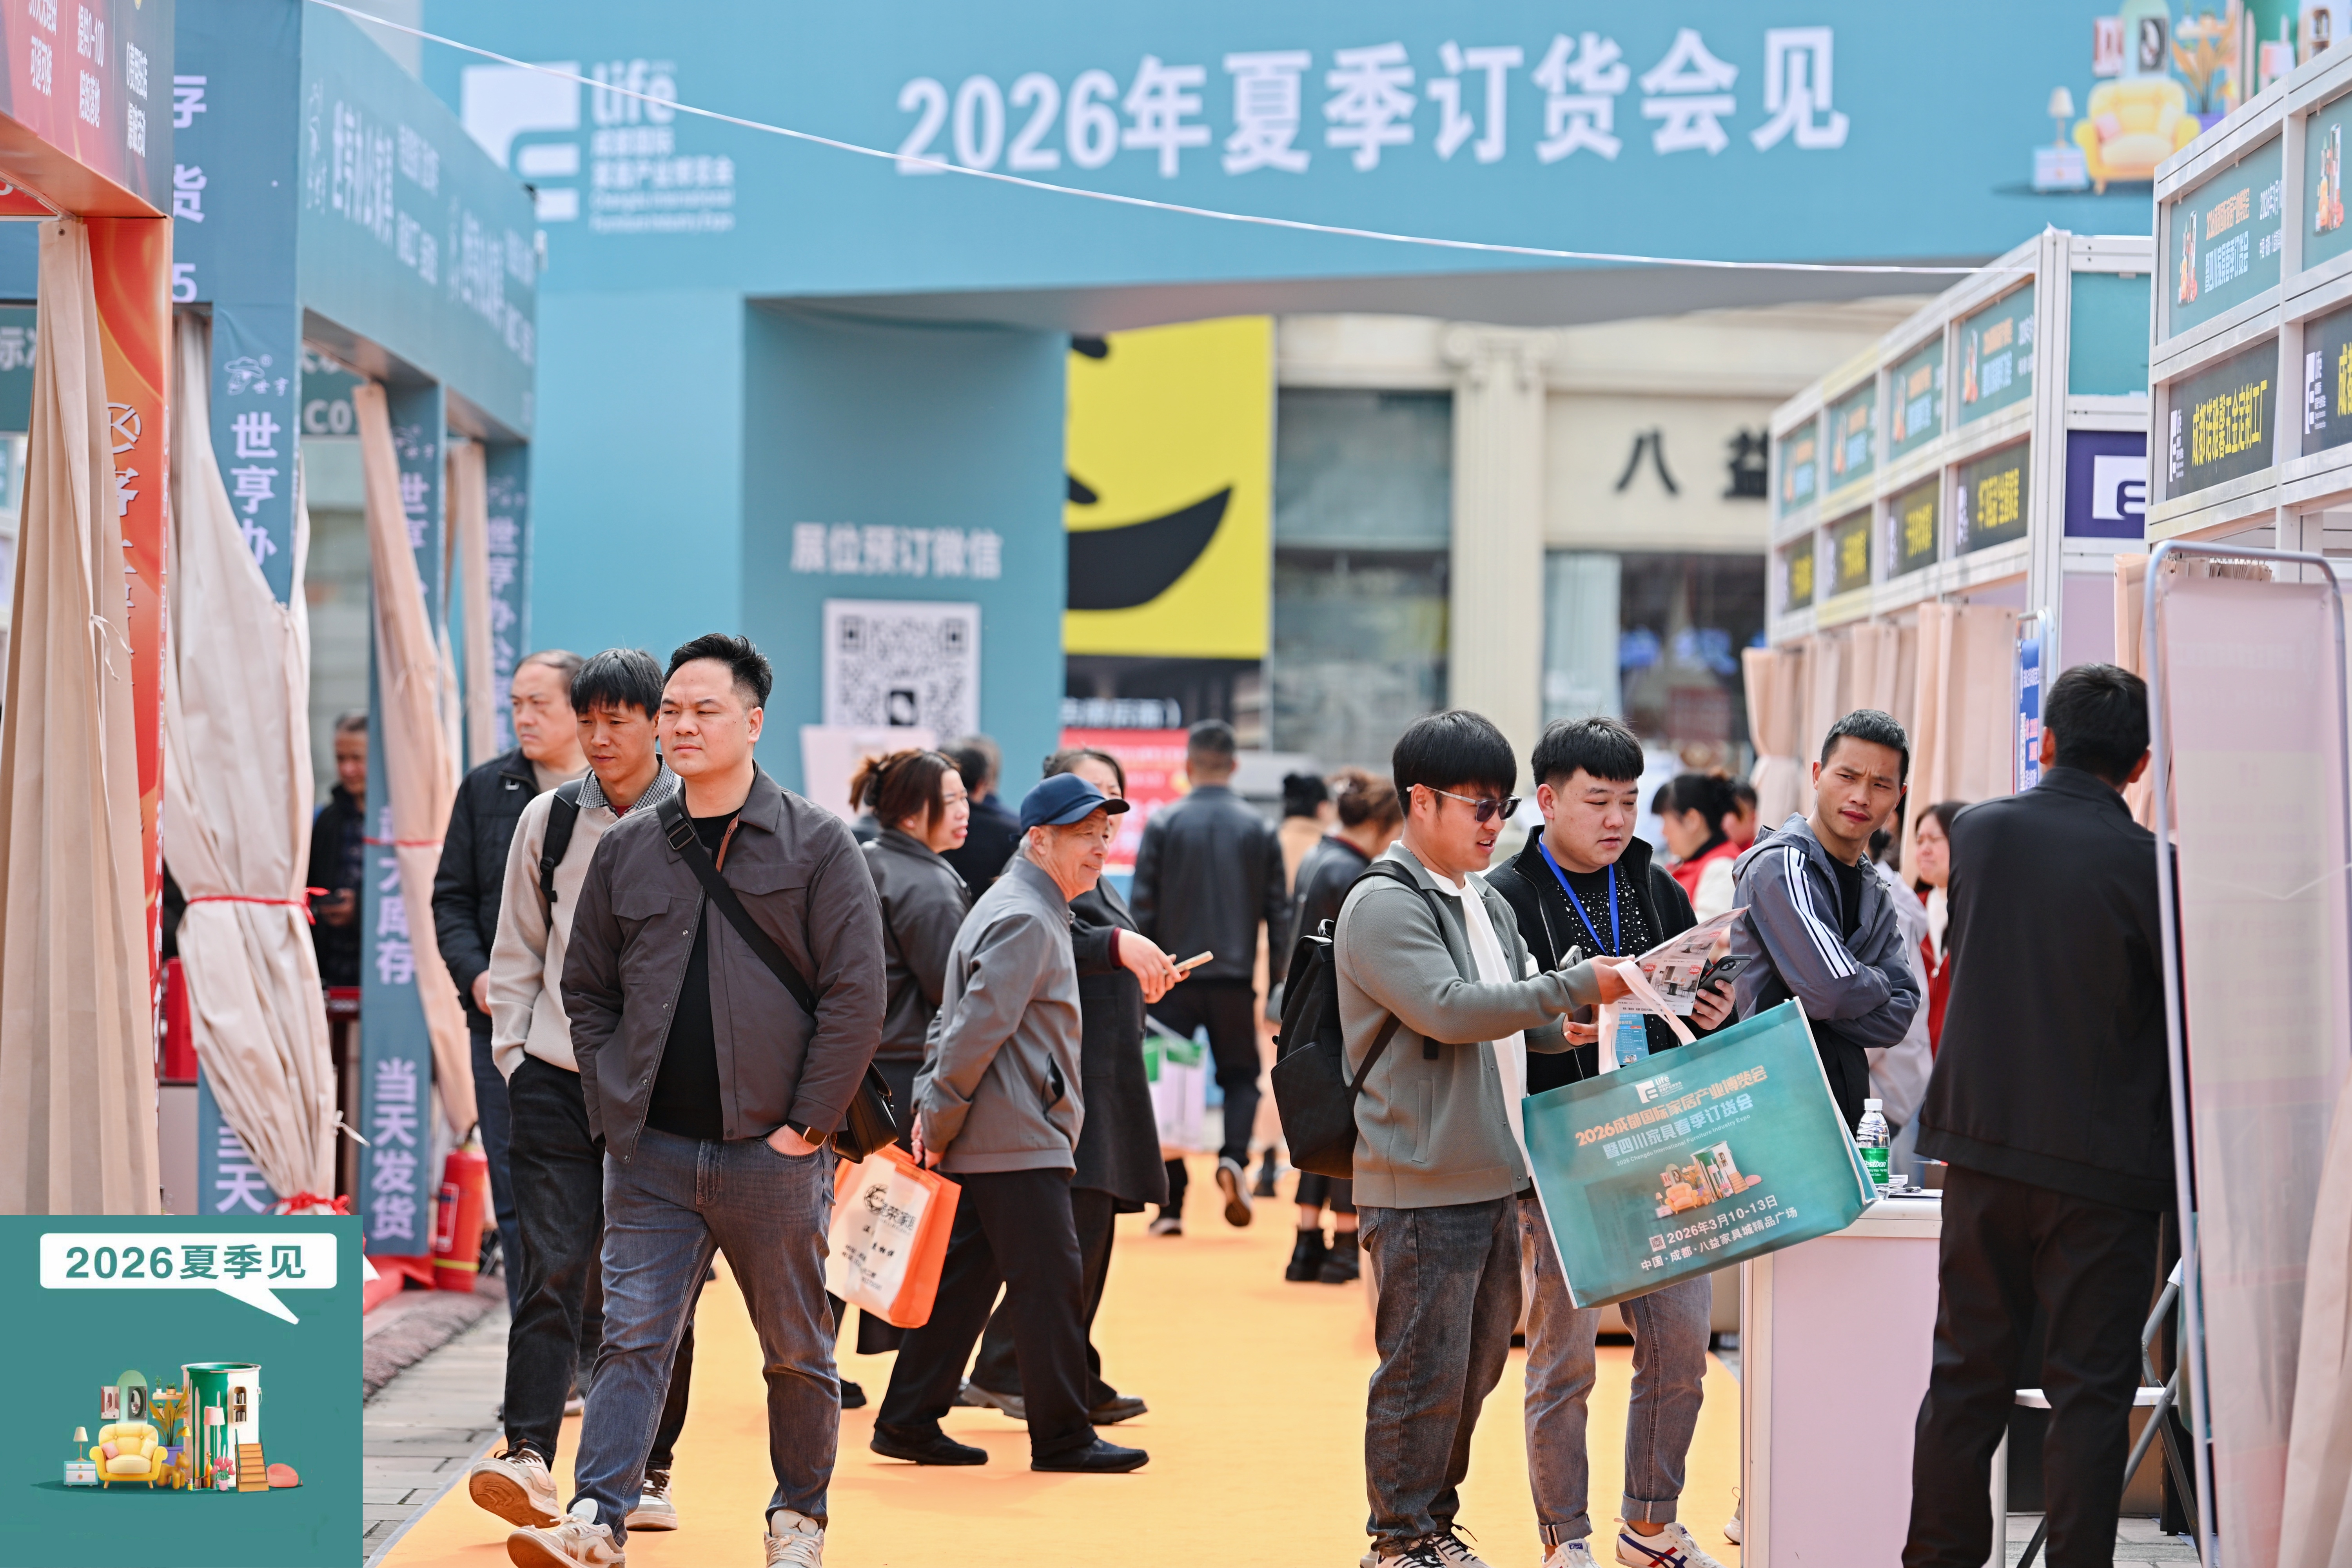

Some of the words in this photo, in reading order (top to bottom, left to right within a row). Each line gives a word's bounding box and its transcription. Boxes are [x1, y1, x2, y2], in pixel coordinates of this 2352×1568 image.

[31, 35, 53, 97] 可退可换
[894, 26, 1850, 177] 2026年夏季订货会见
[790, 522, 1002, 580] 展位预订微信
[1575, 1065, 1768, 1146] 2026成都国际家居产业博览会
[1655, 1076, 1670, 1085] life
[371, 1058, 418, 1241] 当天发货
[1603, 1093, 1754, 1159] 暨四川家具春季订货会
[1617, 1158, 1630, 1167] 2026
[1631, 1151, 1654, 1162] Chengdu
[1653, 1140, 1686, 1154] International
[1687, 1130, 1712, 1143] Furniture
[1713, 1121, 1736, 1133] Industry
[1736, 1114, 1751, 1123] Expo
[1641, 1207, 1798, 1271] 中国·成都·八益家具城精品广场
[1667, 1195, 1778, 1244] 2026年3月10-13日
